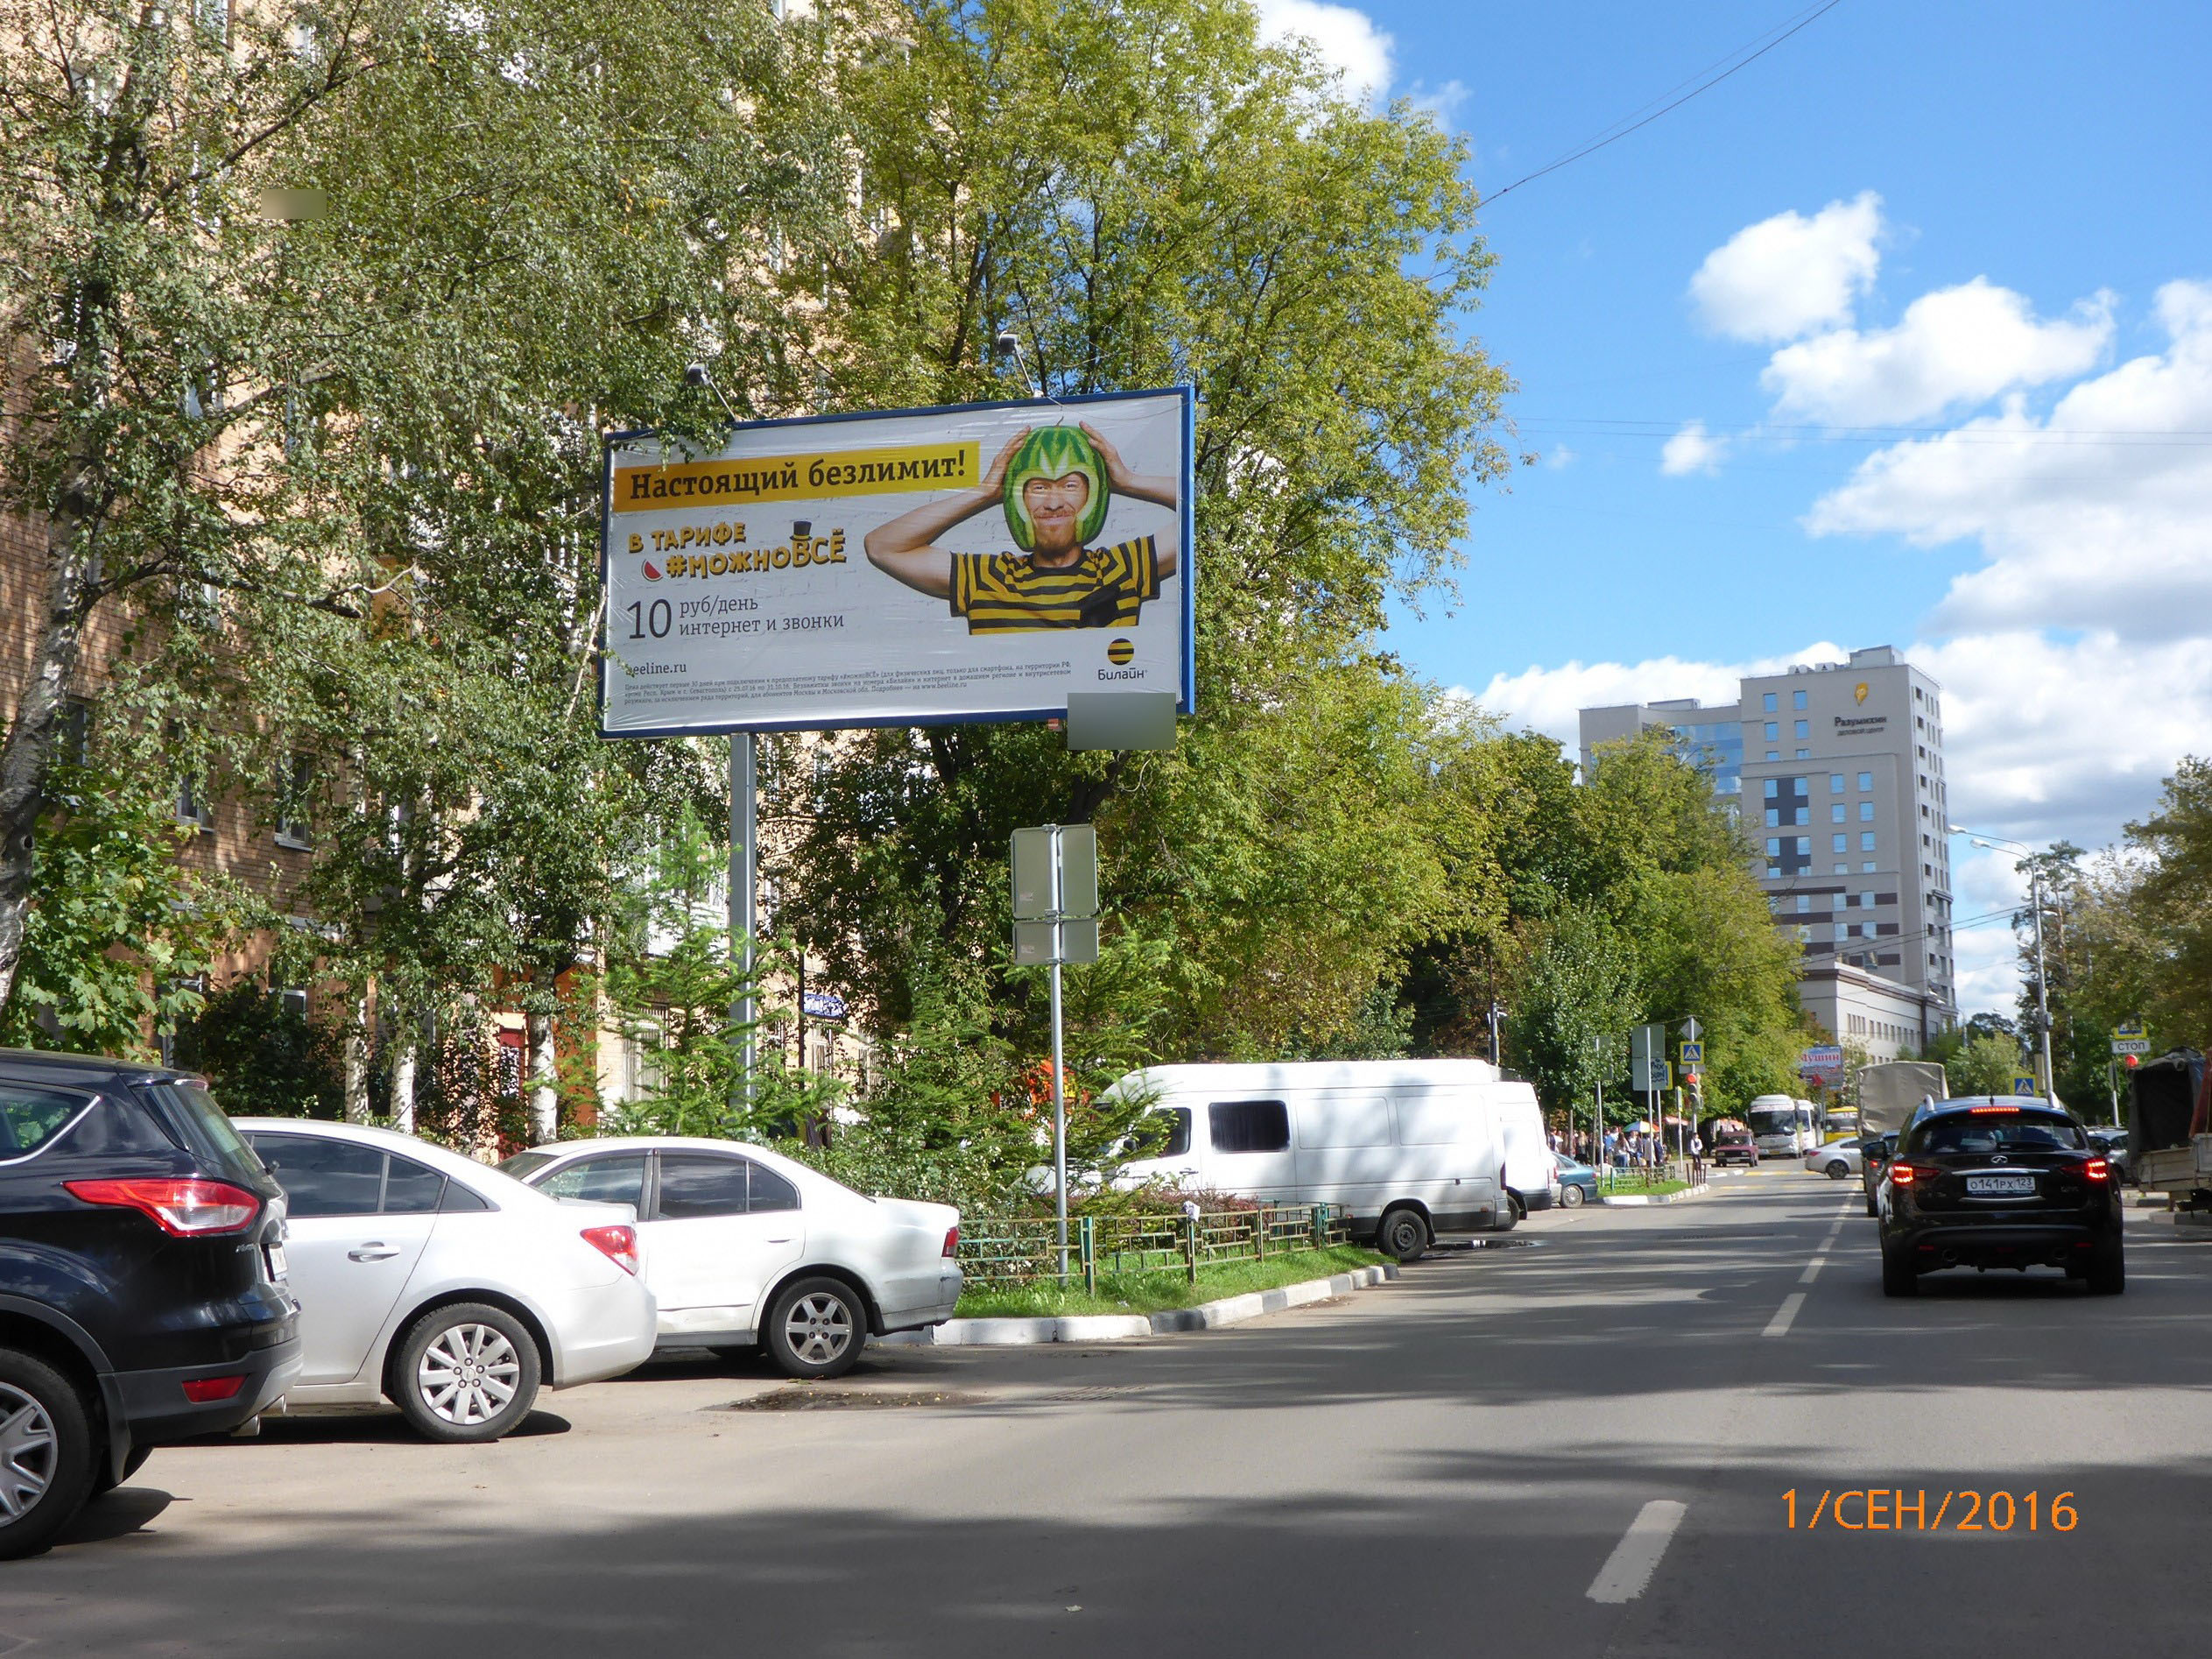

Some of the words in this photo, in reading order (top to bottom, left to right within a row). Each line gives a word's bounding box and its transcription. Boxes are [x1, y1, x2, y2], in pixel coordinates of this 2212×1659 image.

[630, 462, 798, 499] Настоящий
[808, 450, 966, 486] безлимит!
[651, 521, 747, 552] ТАРИФЕ
[627, 598, 672, 639] 10
[680, 596, 758, 618] руб/день
[680, 618, 761, 638] интернет
[766, 618, 777, 631] и
[783, 614, 844, 631] звонки
[1098, 667, 1144, 681] Билайн
[2117, 1042, 2145, 1051] СТОП
